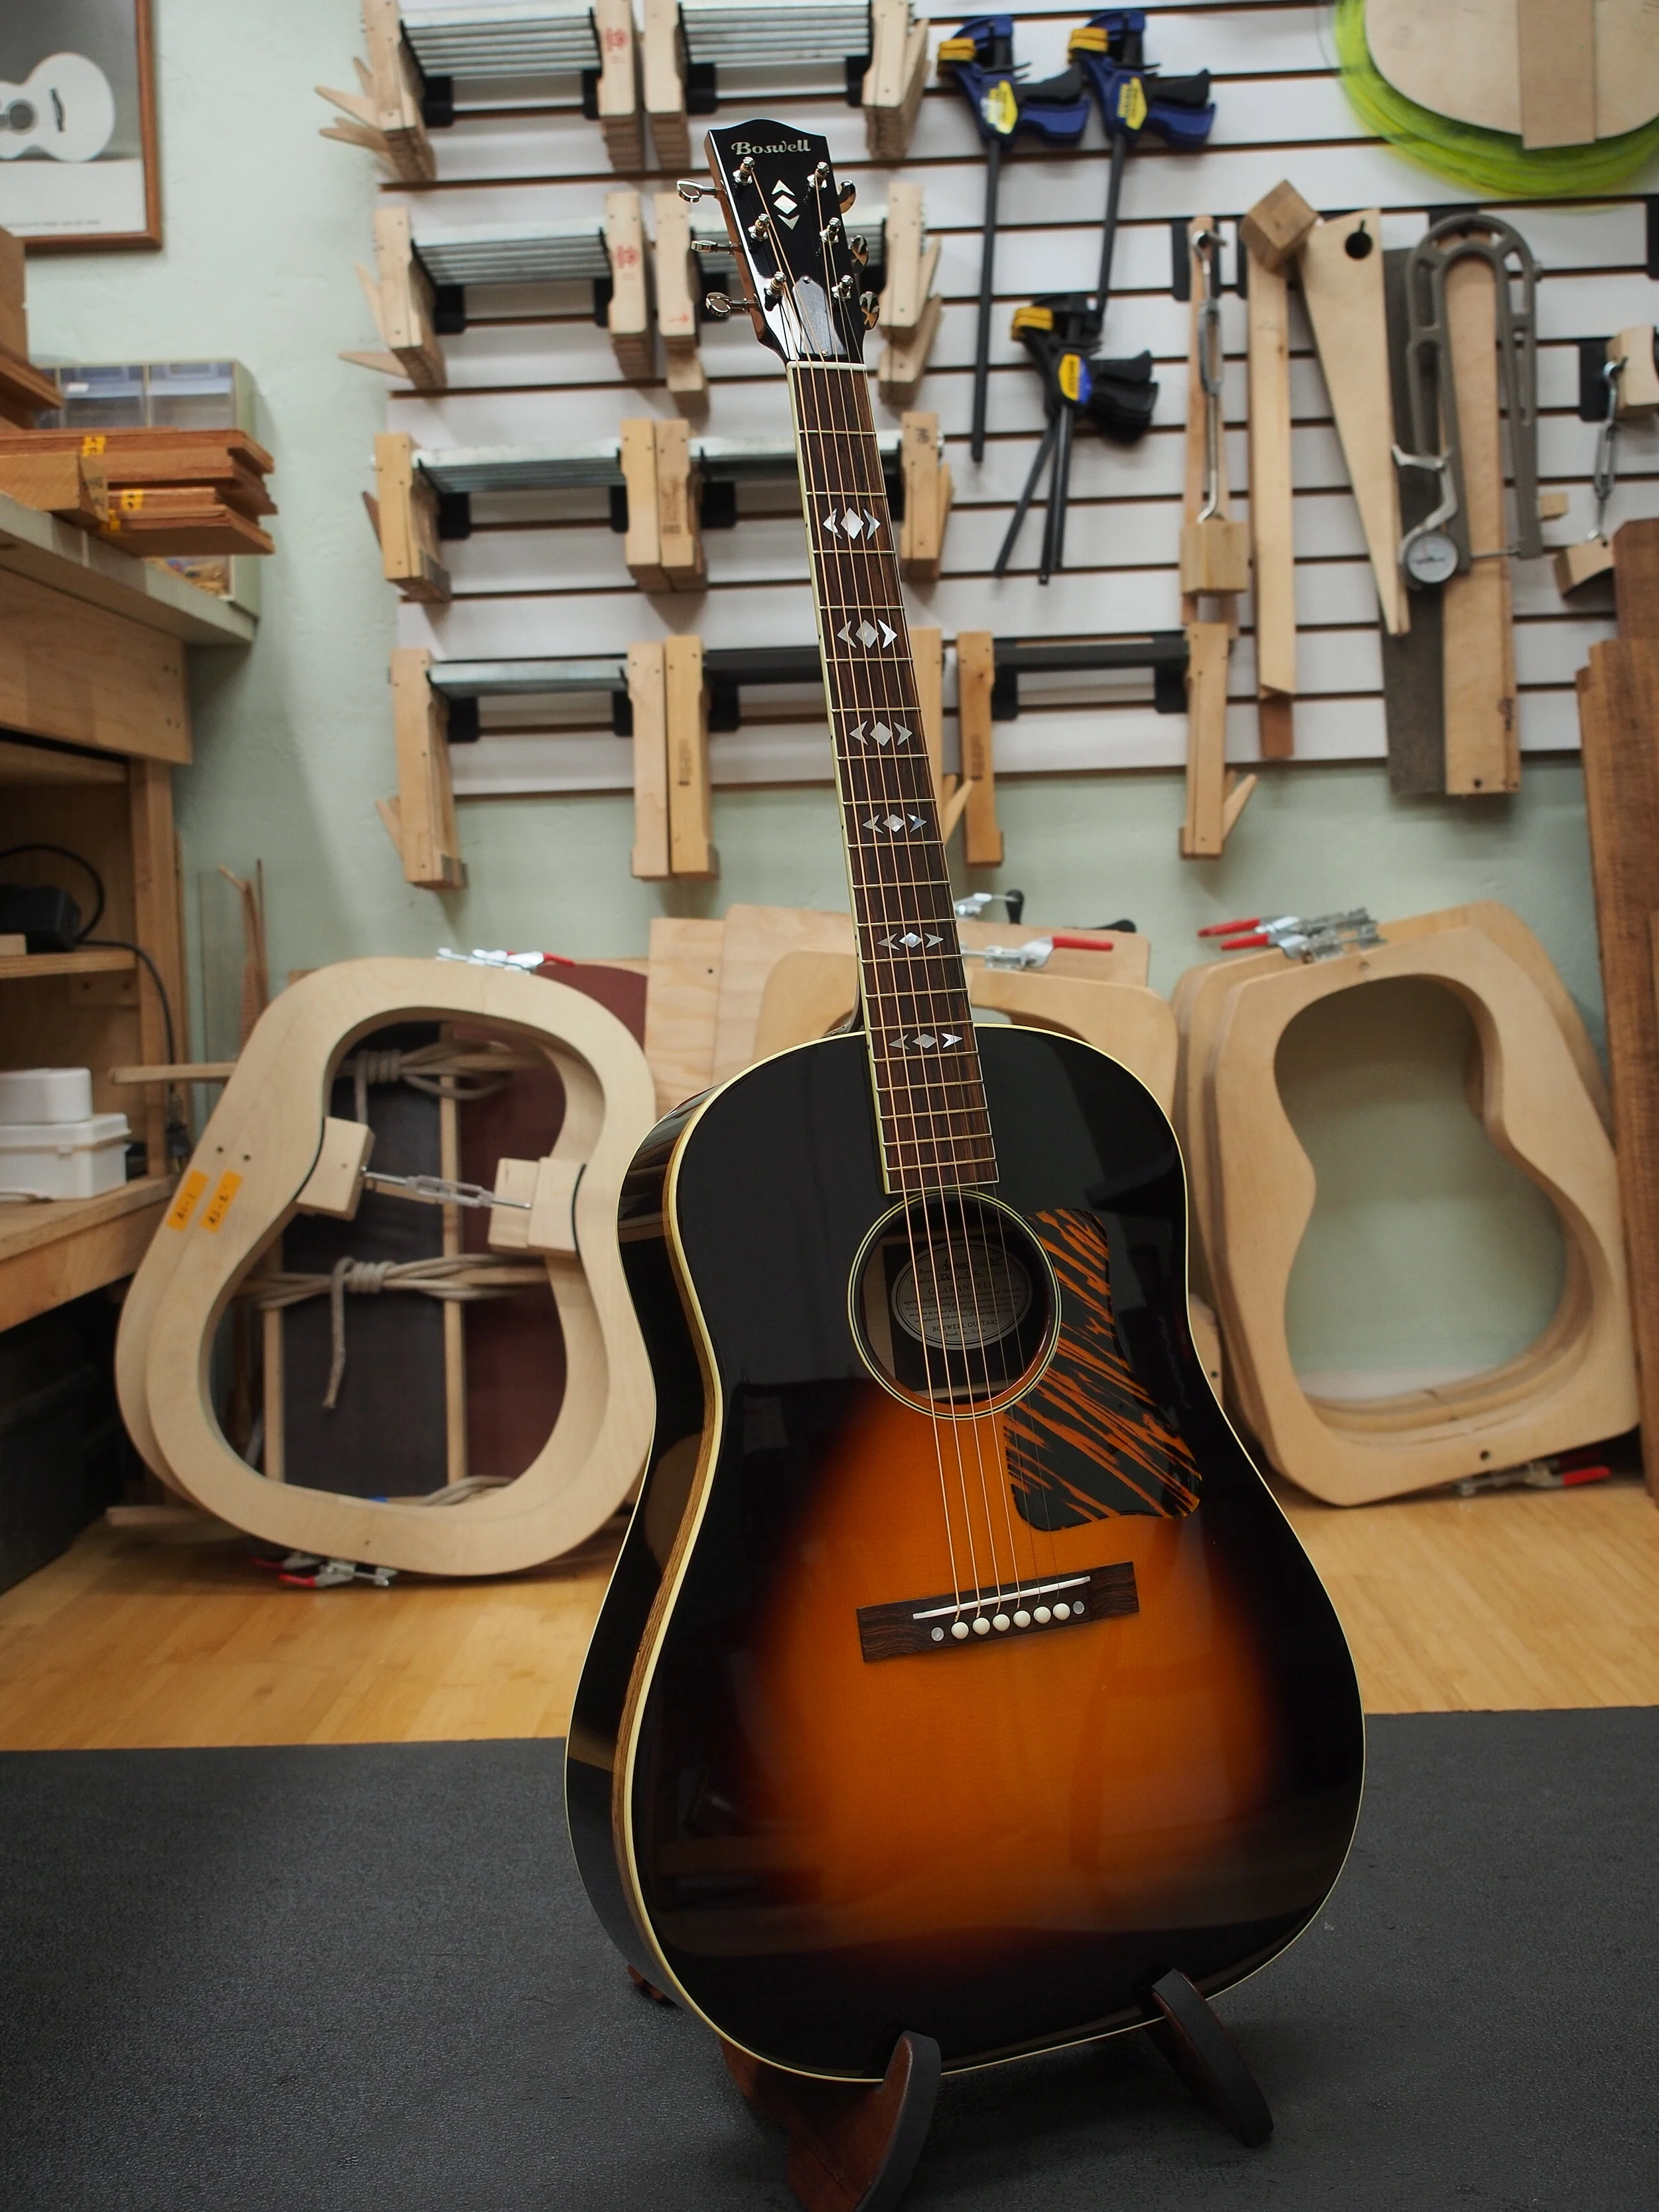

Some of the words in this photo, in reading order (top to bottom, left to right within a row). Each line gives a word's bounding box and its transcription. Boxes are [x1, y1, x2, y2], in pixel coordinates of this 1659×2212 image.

[731, 139, 812, 155] Boswell
[928, 1281, 995, 1295] GUARANEED
[968, 1319, 1000, 1328] GUTARS
